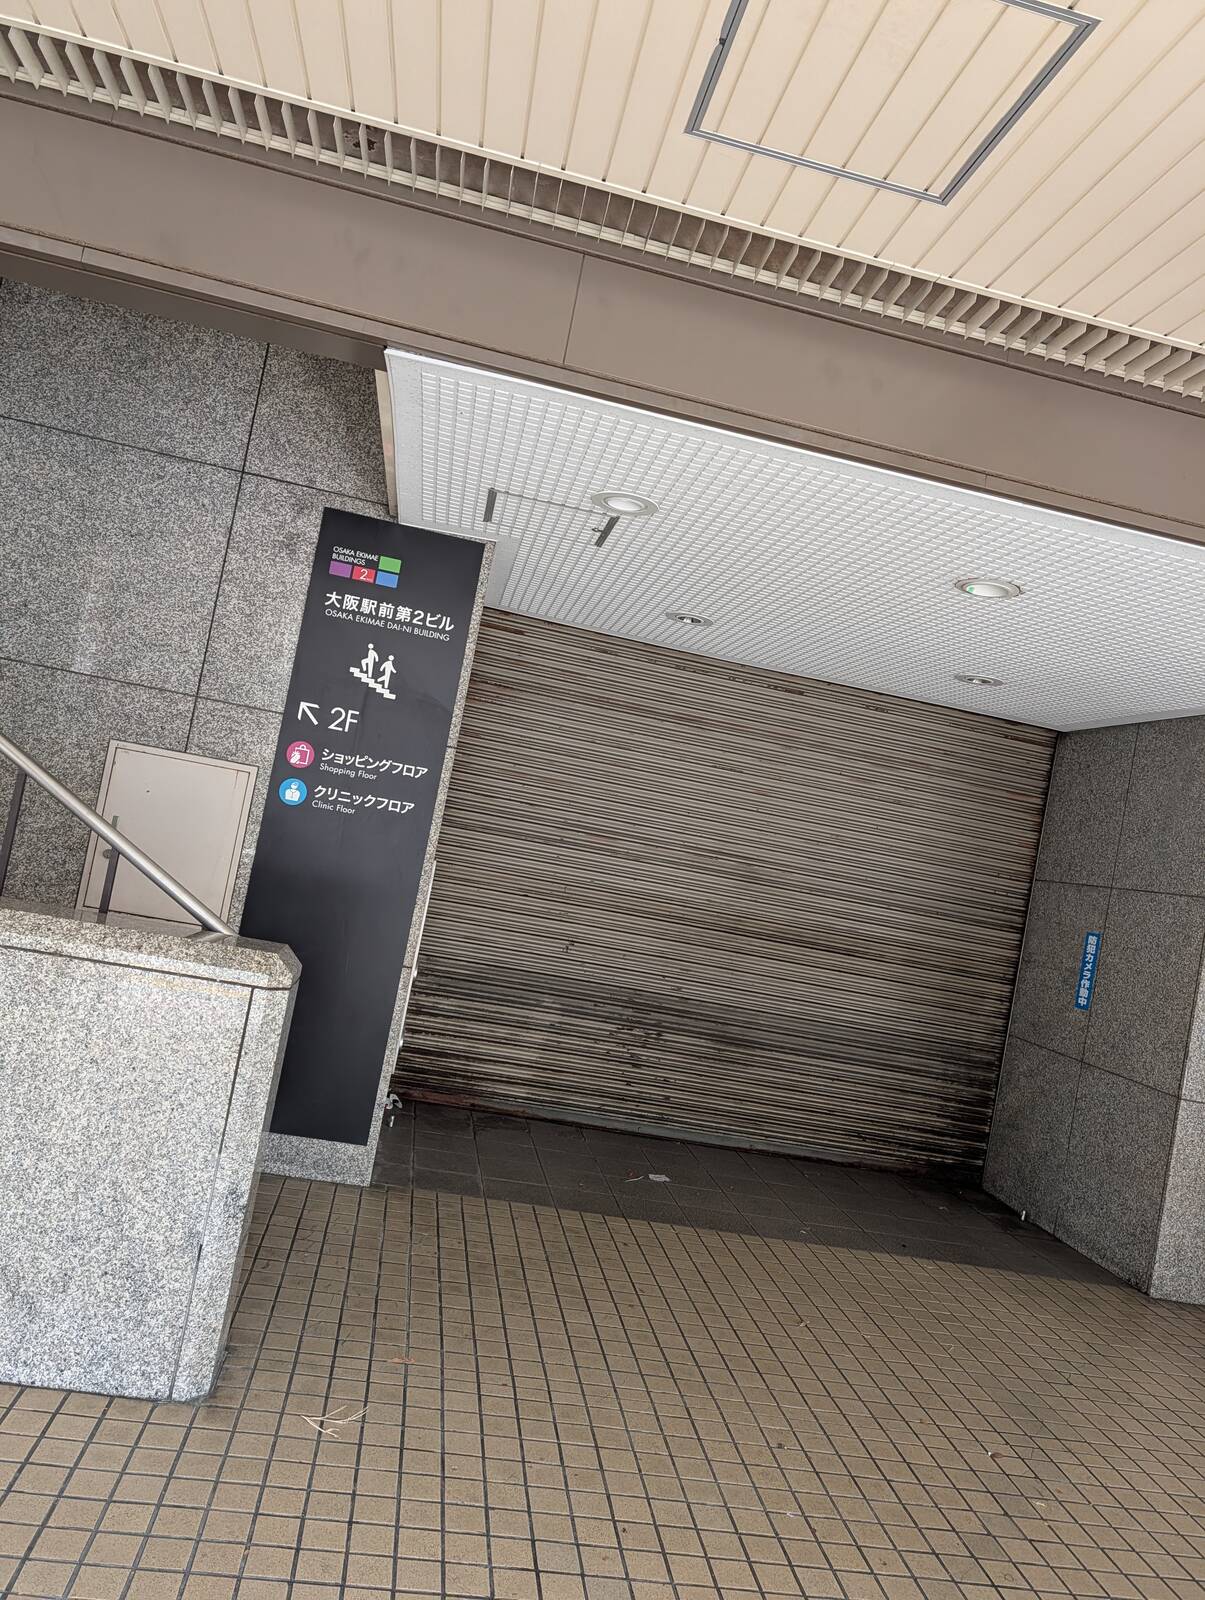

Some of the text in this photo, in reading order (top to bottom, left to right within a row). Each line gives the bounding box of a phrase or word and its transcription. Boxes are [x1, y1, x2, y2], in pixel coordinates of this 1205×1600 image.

[332, 553, 366, 566] BUILDINGS
[333, 546, 379, 562] OSAKA EKIMAE
[360, 568, 368, 581] 2
[324, 591, 455, 632] 大阪駅前第2ビル
[325, 608, 450, 642] OSAKA EKIMAE DAI-NI BUILDING
[327, 707, 360, 733] 2F
[319, 763, 378, 781] Shopping Floor
[321, 748, 429, 779] ショッピングフロア
[311, 799, 356, 815] Clinic Floor
[313, 785, 415, 814] クリニックフロア
[1077, 935, 1098, 1007] 防犯カメラ作動中
